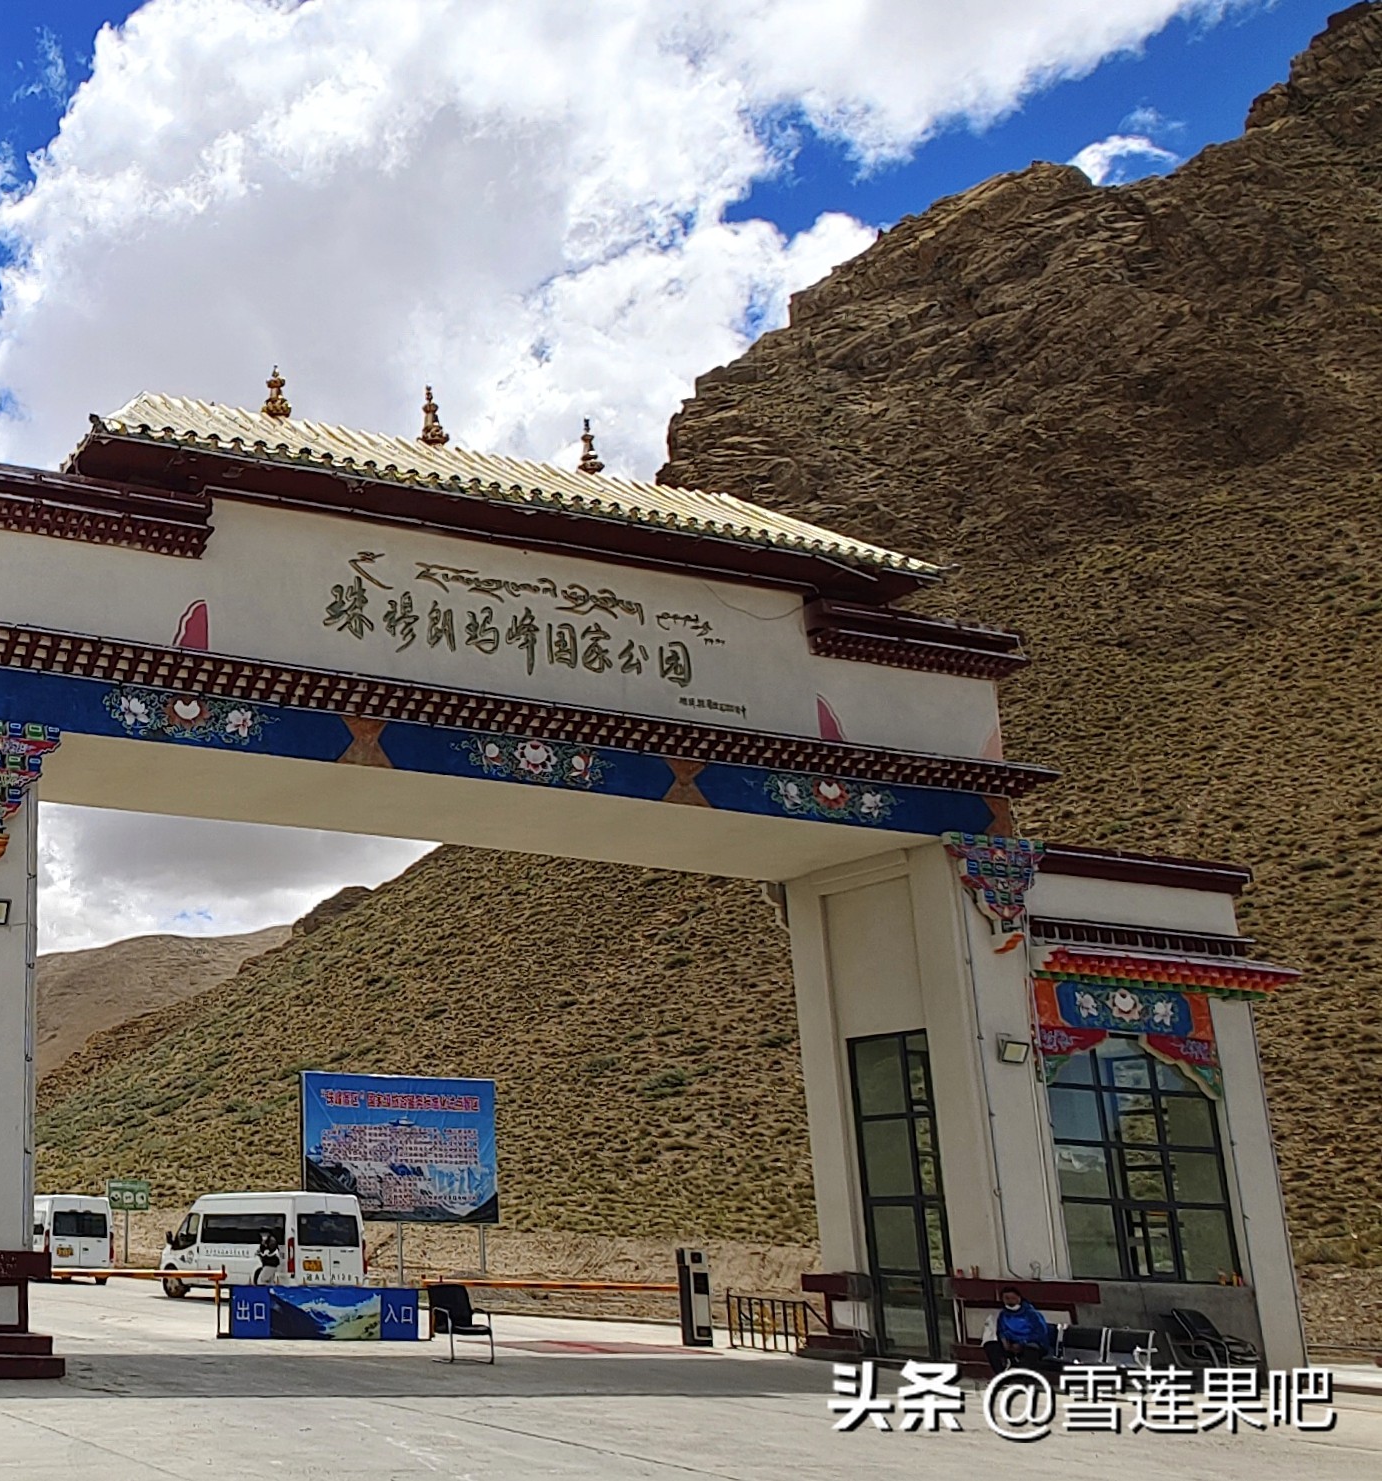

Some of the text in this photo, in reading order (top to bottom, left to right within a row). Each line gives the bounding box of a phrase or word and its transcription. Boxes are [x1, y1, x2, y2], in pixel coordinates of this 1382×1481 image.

[323, 577, 693, 688] 珠穆朗玛峰国家公园
[236, 1300, 267, 1321] 出口
[384, 1303, 414, 1324] 入口
